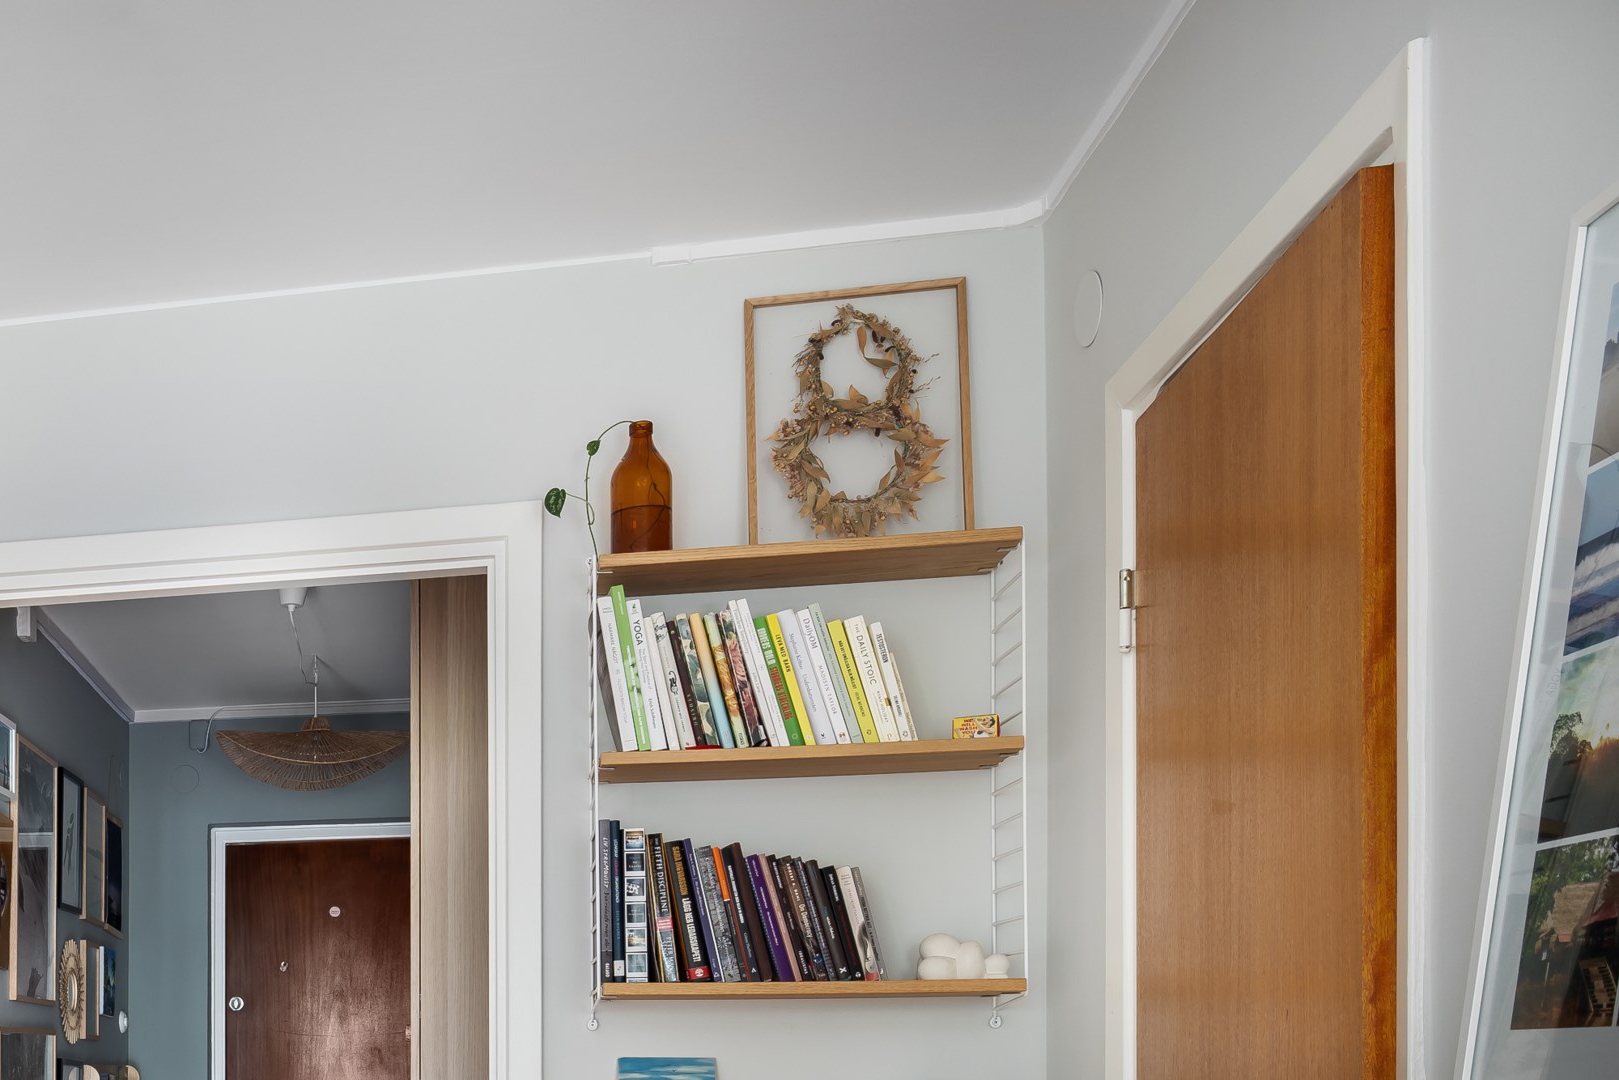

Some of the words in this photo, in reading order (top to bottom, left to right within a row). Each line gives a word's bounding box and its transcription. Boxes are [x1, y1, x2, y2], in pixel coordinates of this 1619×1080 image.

[633, 619, 644, 646] YOGA
[803, 618, 818, 650] DailyOM
[783, 659, 791, 673] BARN
[856, 635, 867, 658] DAILY
[863, 661, 877, 685] STOIC
[654, 846, 663, 870] FIFTH
[655, 871, 668, 913] DISCIPLINE
[799, 904, 806, 912] On
